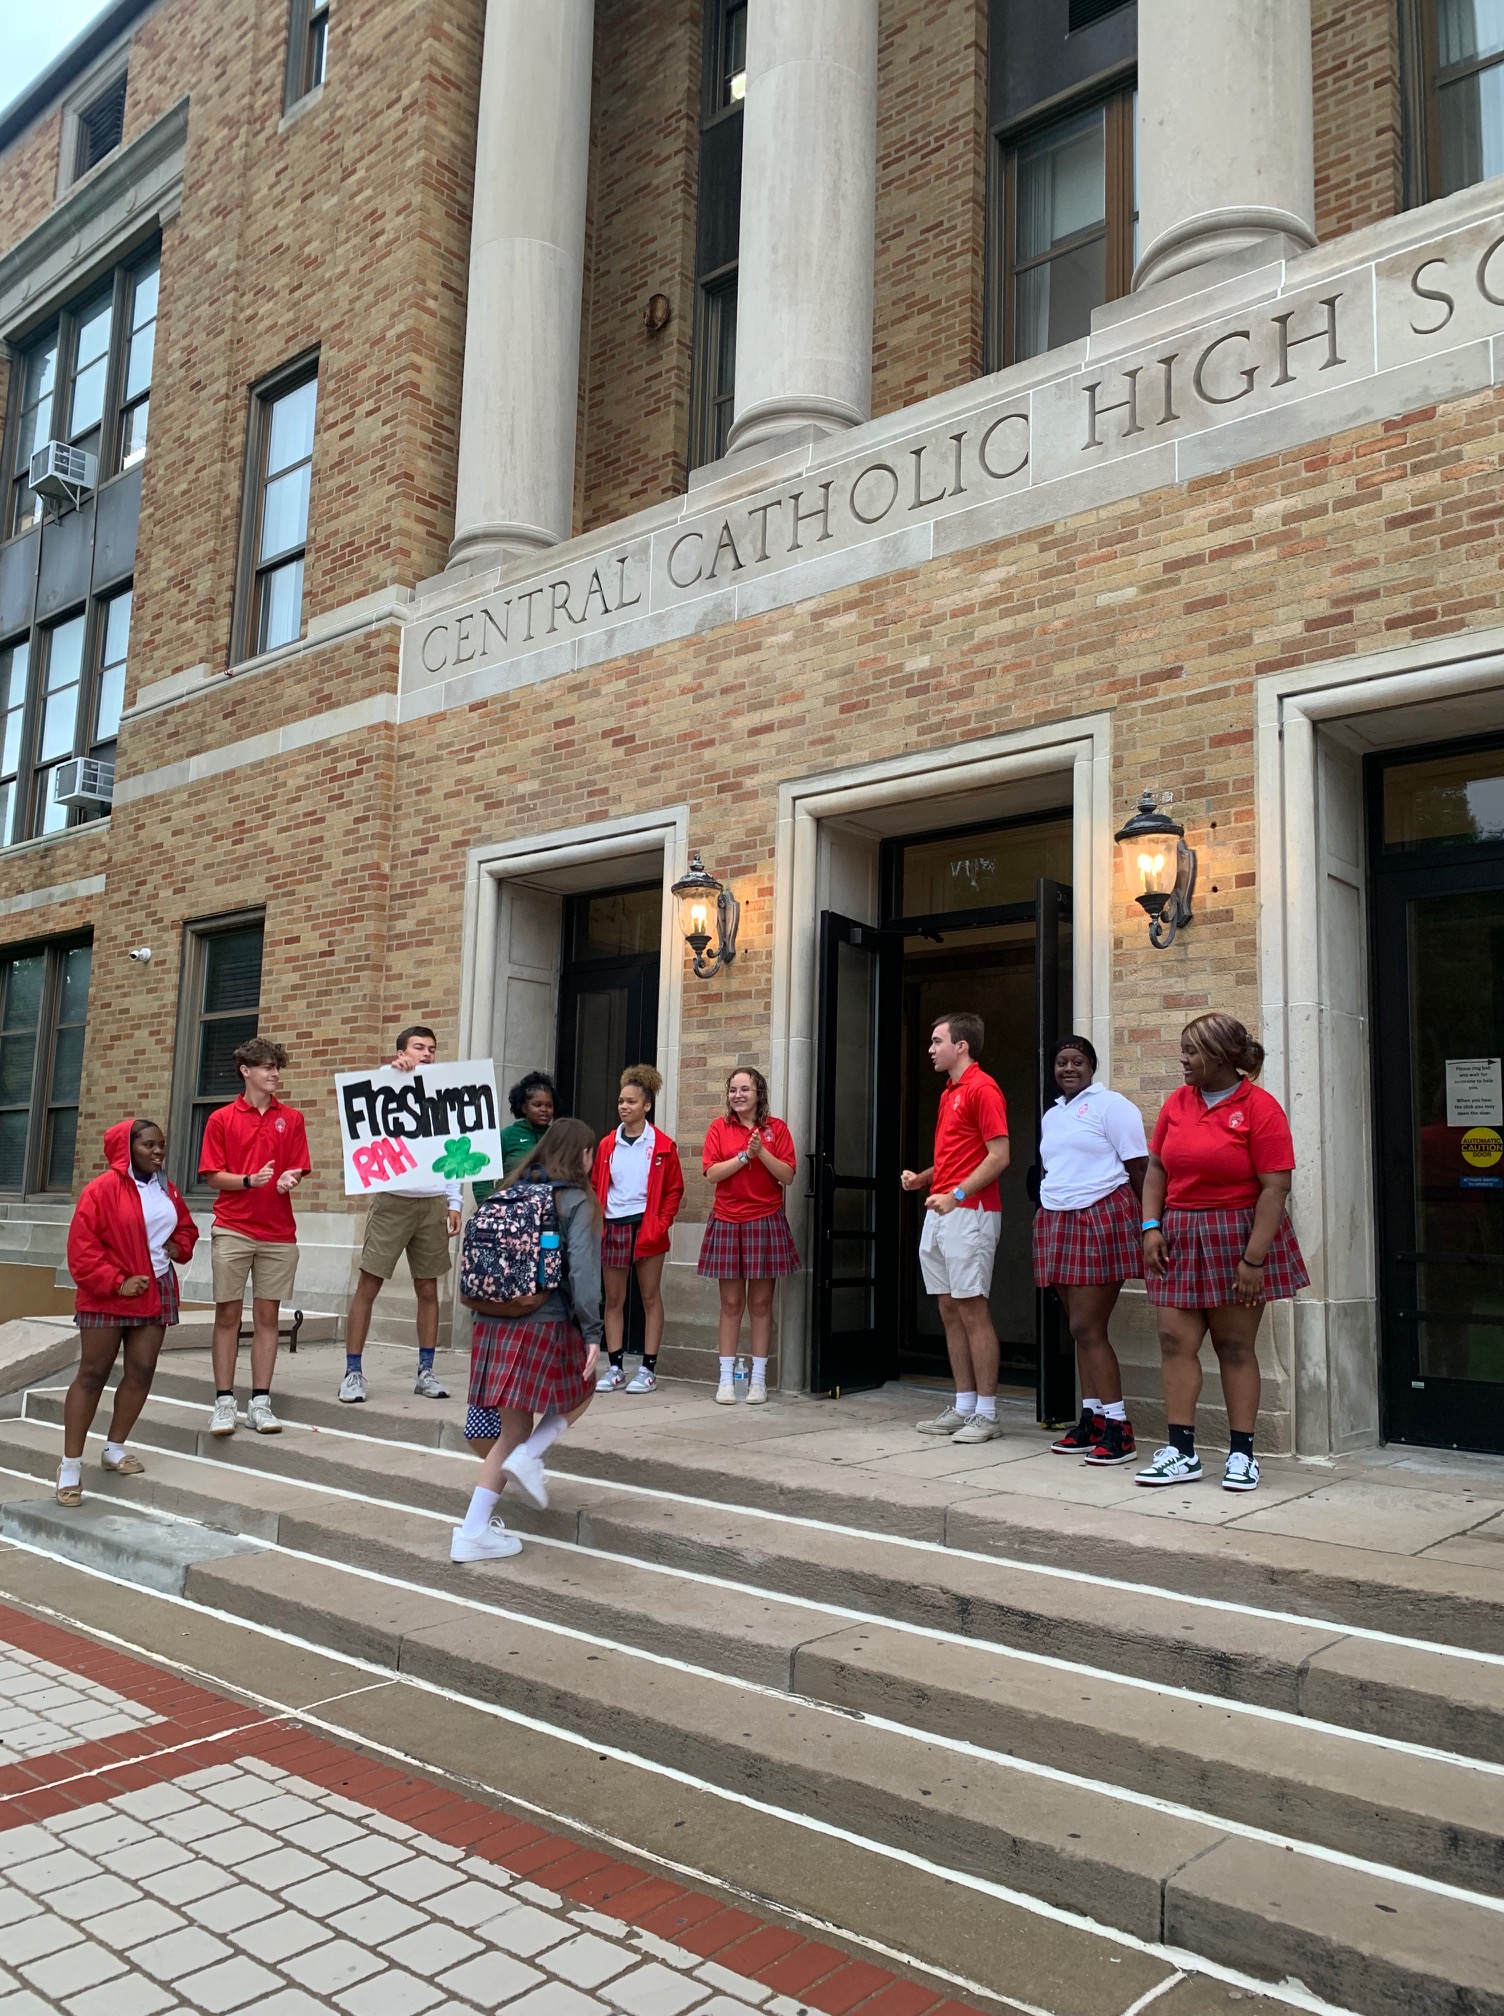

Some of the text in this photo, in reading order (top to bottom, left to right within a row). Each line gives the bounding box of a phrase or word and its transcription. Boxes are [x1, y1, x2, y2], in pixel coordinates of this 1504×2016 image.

[421, 555, 642, 673] CENTRAL
[666, 413, 1030, 589] CATHOLIC
[1081, 292, 1347, 451] HIGH
[342, 1075, 496, 1140] Freshmen
[352, 1135, 418, 1188] RAH
